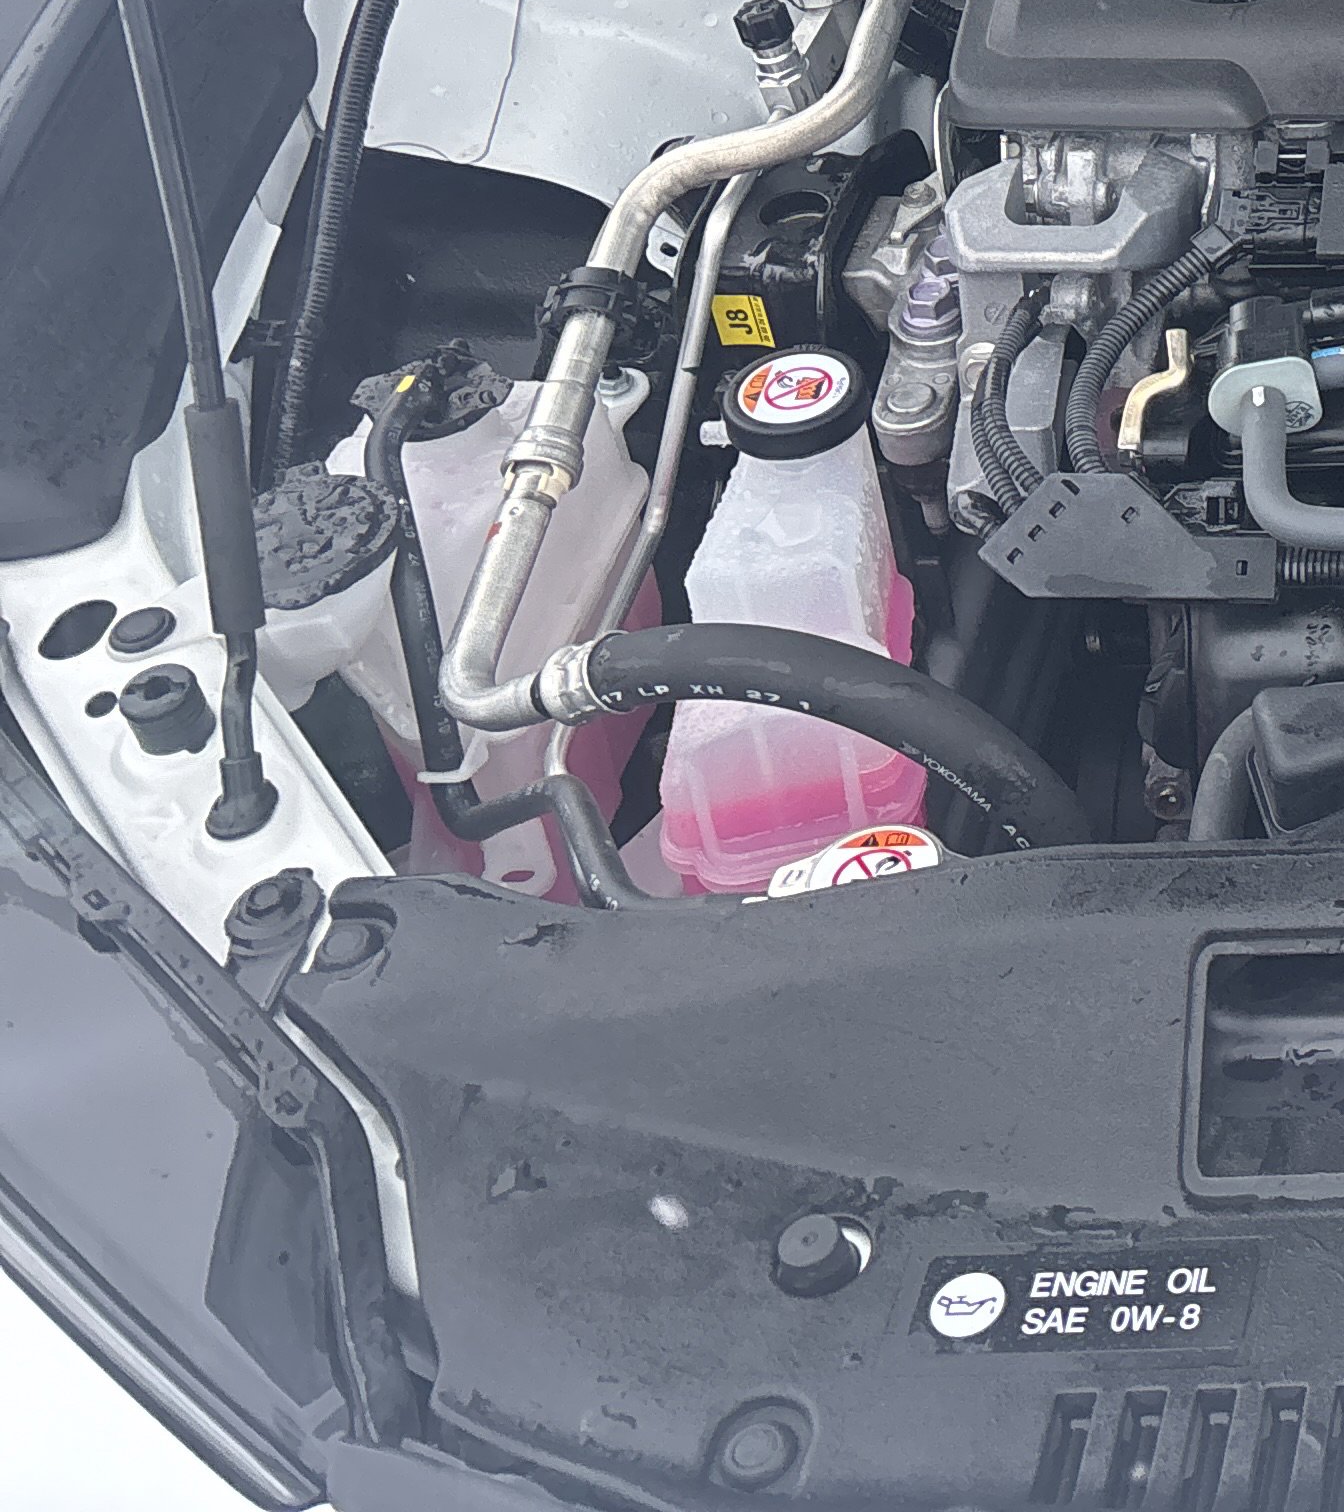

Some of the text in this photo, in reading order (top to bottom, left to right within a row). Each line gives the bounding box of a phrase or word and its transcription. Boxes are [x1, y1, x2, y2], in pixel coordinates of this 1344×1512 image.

[725, 309, 753, 335] J8
[689, 684, 724, 695] XH
[922, 753, 992, 813] YOKOHAMA
[1030, 1268, 1216, 1298] ENGINE OIL
[1021, 1304, 1201, 1335] SAE 0W-8
